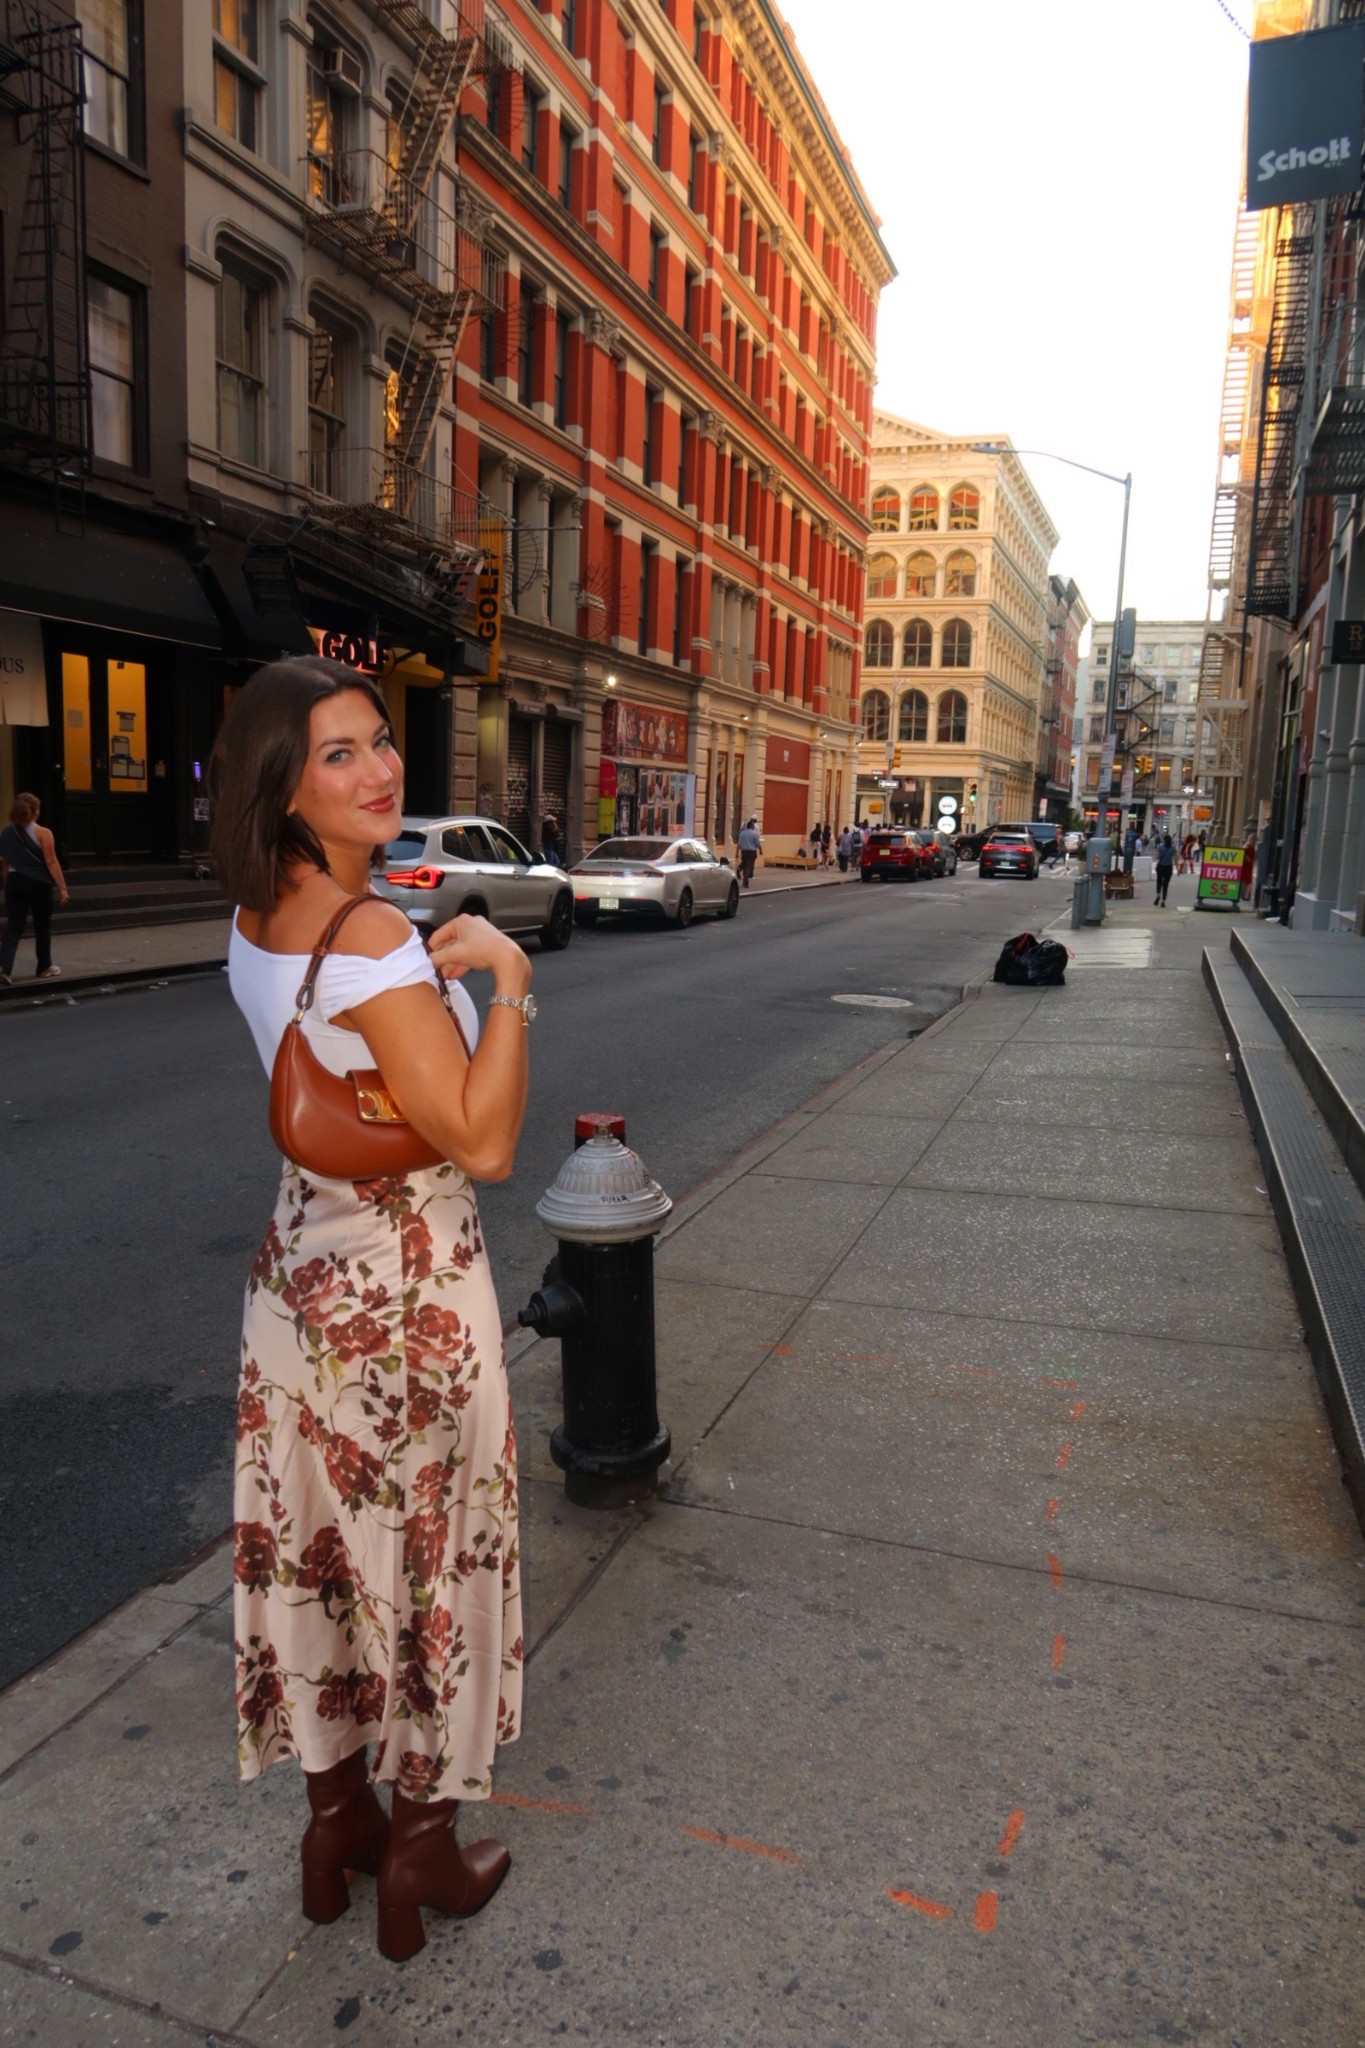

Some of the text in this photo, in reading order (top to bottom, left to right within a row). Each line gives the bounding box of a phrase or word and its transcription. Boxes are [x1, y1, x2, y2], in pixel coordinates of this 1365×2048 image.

[1257, 137, 1351, 182] Schott
[1210, 850, 1238, 862] ANY
[1206, 866, 1238, 880] ITEM
